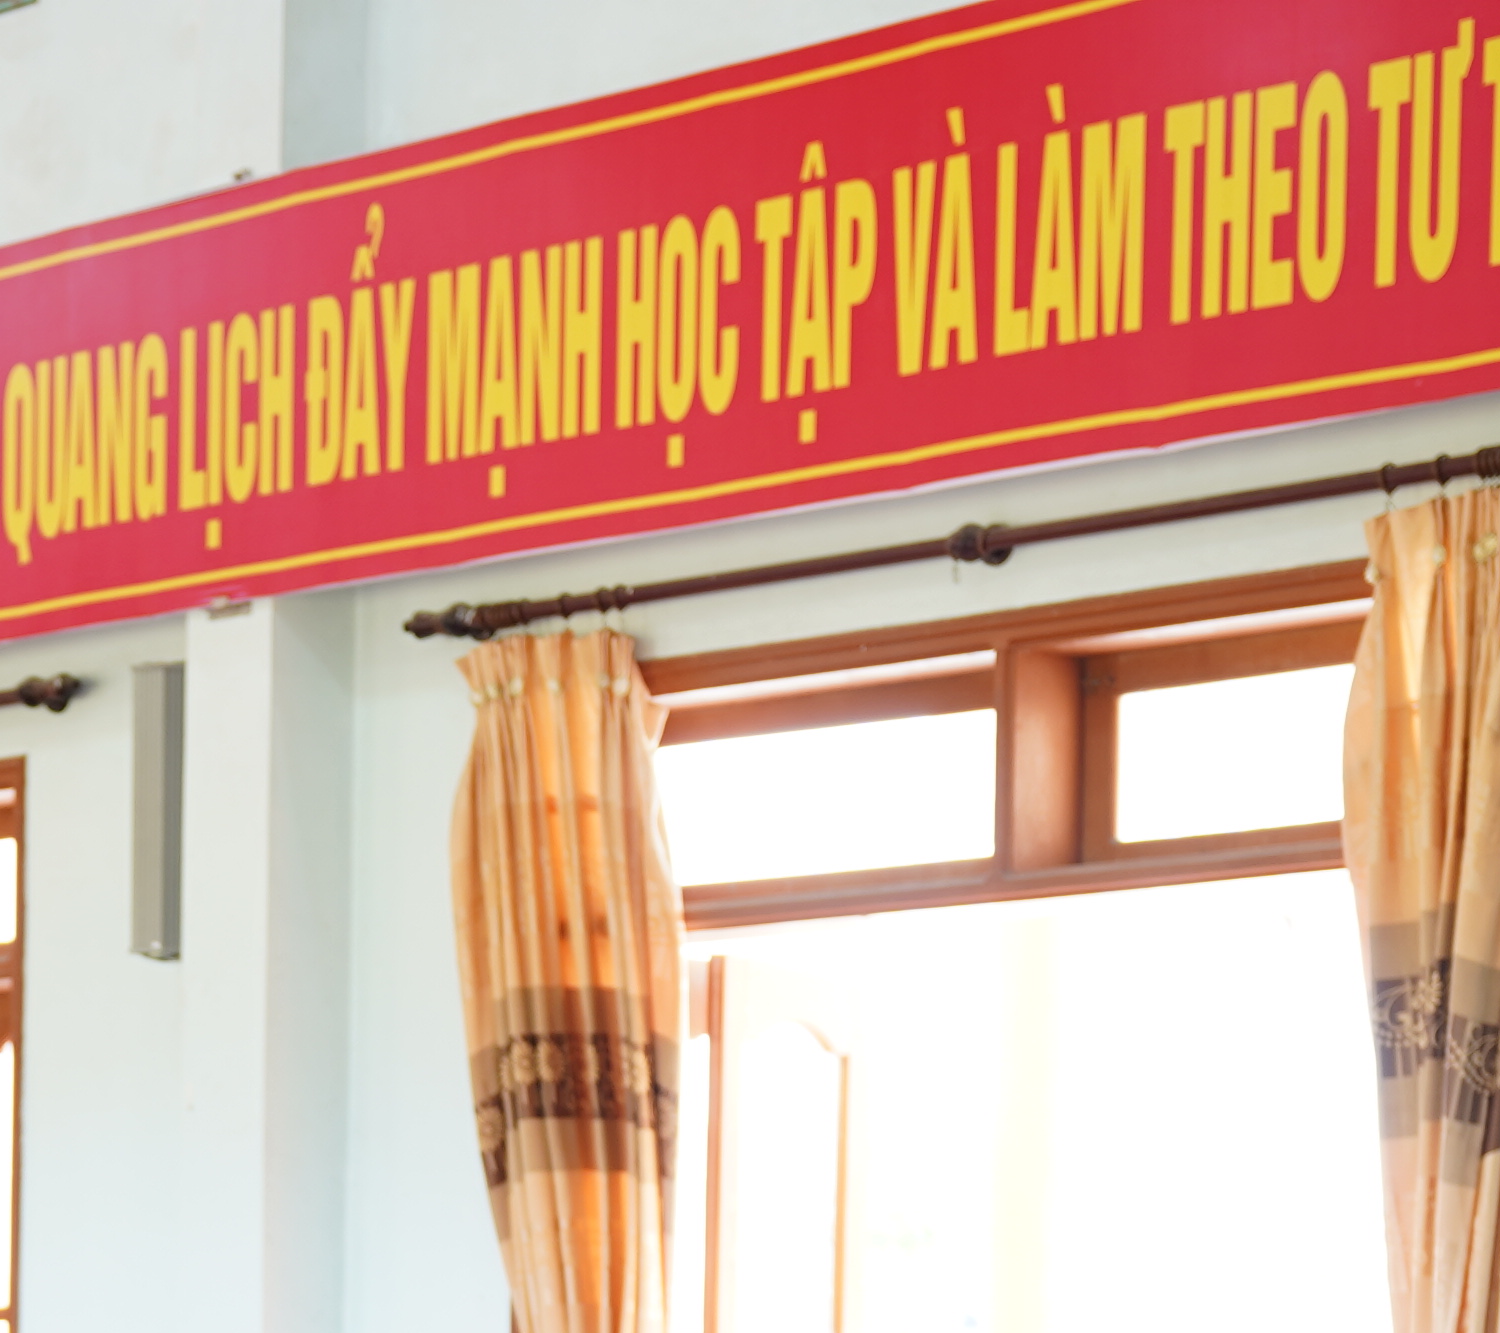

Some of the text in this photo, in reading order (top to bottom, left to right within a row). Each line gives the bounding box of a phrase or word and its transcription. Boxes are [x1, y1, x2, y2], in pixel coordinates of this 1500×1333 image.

[2, 335, 168, 564] QUANG
[177, 303, 295, 549] LỊCH
[304, 202, 416, 488] ĐẨY
[425, 236, 602, 498] MẠNH
[615, 205, 741, 468] HỌC
[755, 140, 878, 444] TẬP
[893, 106, 979, 377] VÀ
[993, 83, 1147, 358] LÀM
[1164, 68, 1349, 326] THEO
[1368, 16, 1475, 289] TƯ
